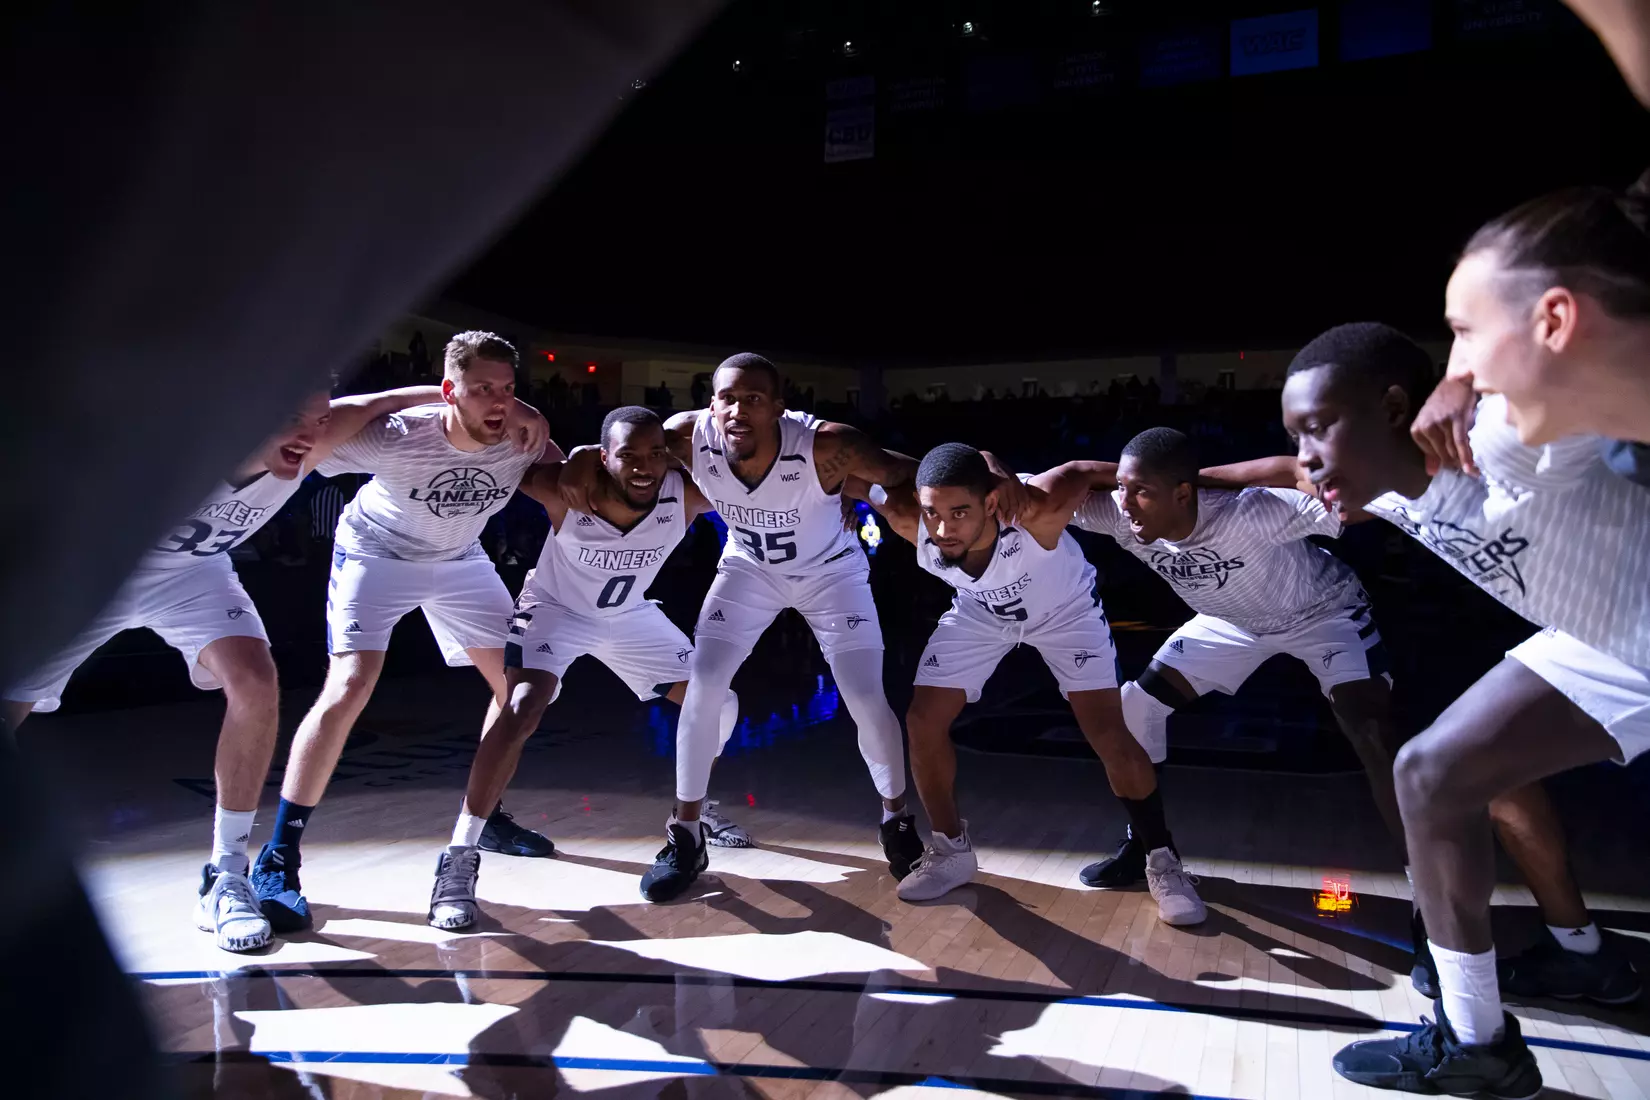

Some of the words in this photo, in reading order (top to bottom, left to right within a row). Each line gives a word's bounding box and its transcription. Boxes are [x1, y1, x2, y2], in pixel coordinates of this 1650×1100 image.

[780, 472, 801, 482] WAC
[408, 485, 511, 503] LANCERS
[715, 500, 801, 529] LANCERS
[735, 526, 797, 565] 35
[1000, 542, 1021, 559] WAC
[578, 546, 665, 571] LANCERS
[1156, 556, 1245, 578] ANCERS
[596, 575, 637, 609] 0
